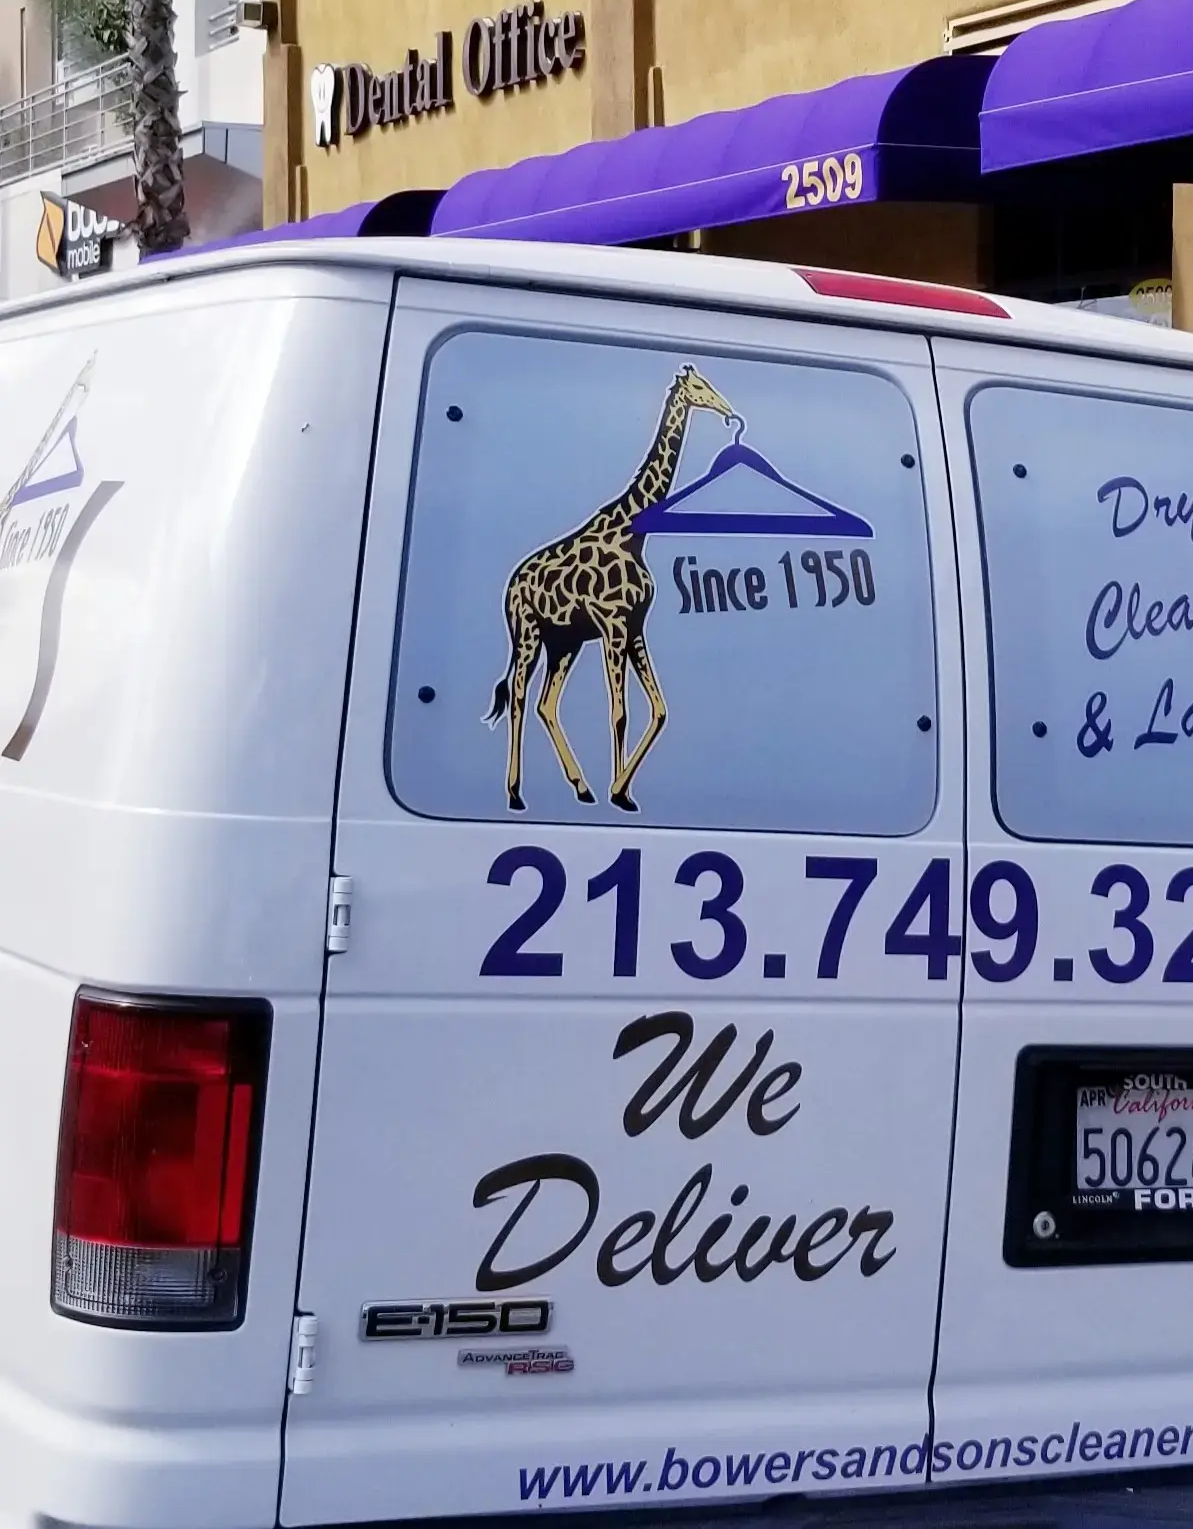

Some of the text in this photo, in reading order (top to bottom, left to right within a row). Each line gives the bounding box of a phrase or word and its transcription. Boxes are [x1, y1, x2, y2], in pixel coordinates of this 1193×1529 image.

[345, 30, 453, 136] Dental
[780, 152, 863, 209] 2509
[66, 237, 101, 270] mobile
[673, 548, 876, 615] Since 1950
[1076, 691, 1114, 759] &
[612, 1010, 803, 1140] We
[1080, 1089, 1107, 1108] APR
[472, 1152, 897, 1292] Deliver
[1072, 1193, 1113, 1205] LINCOLN
